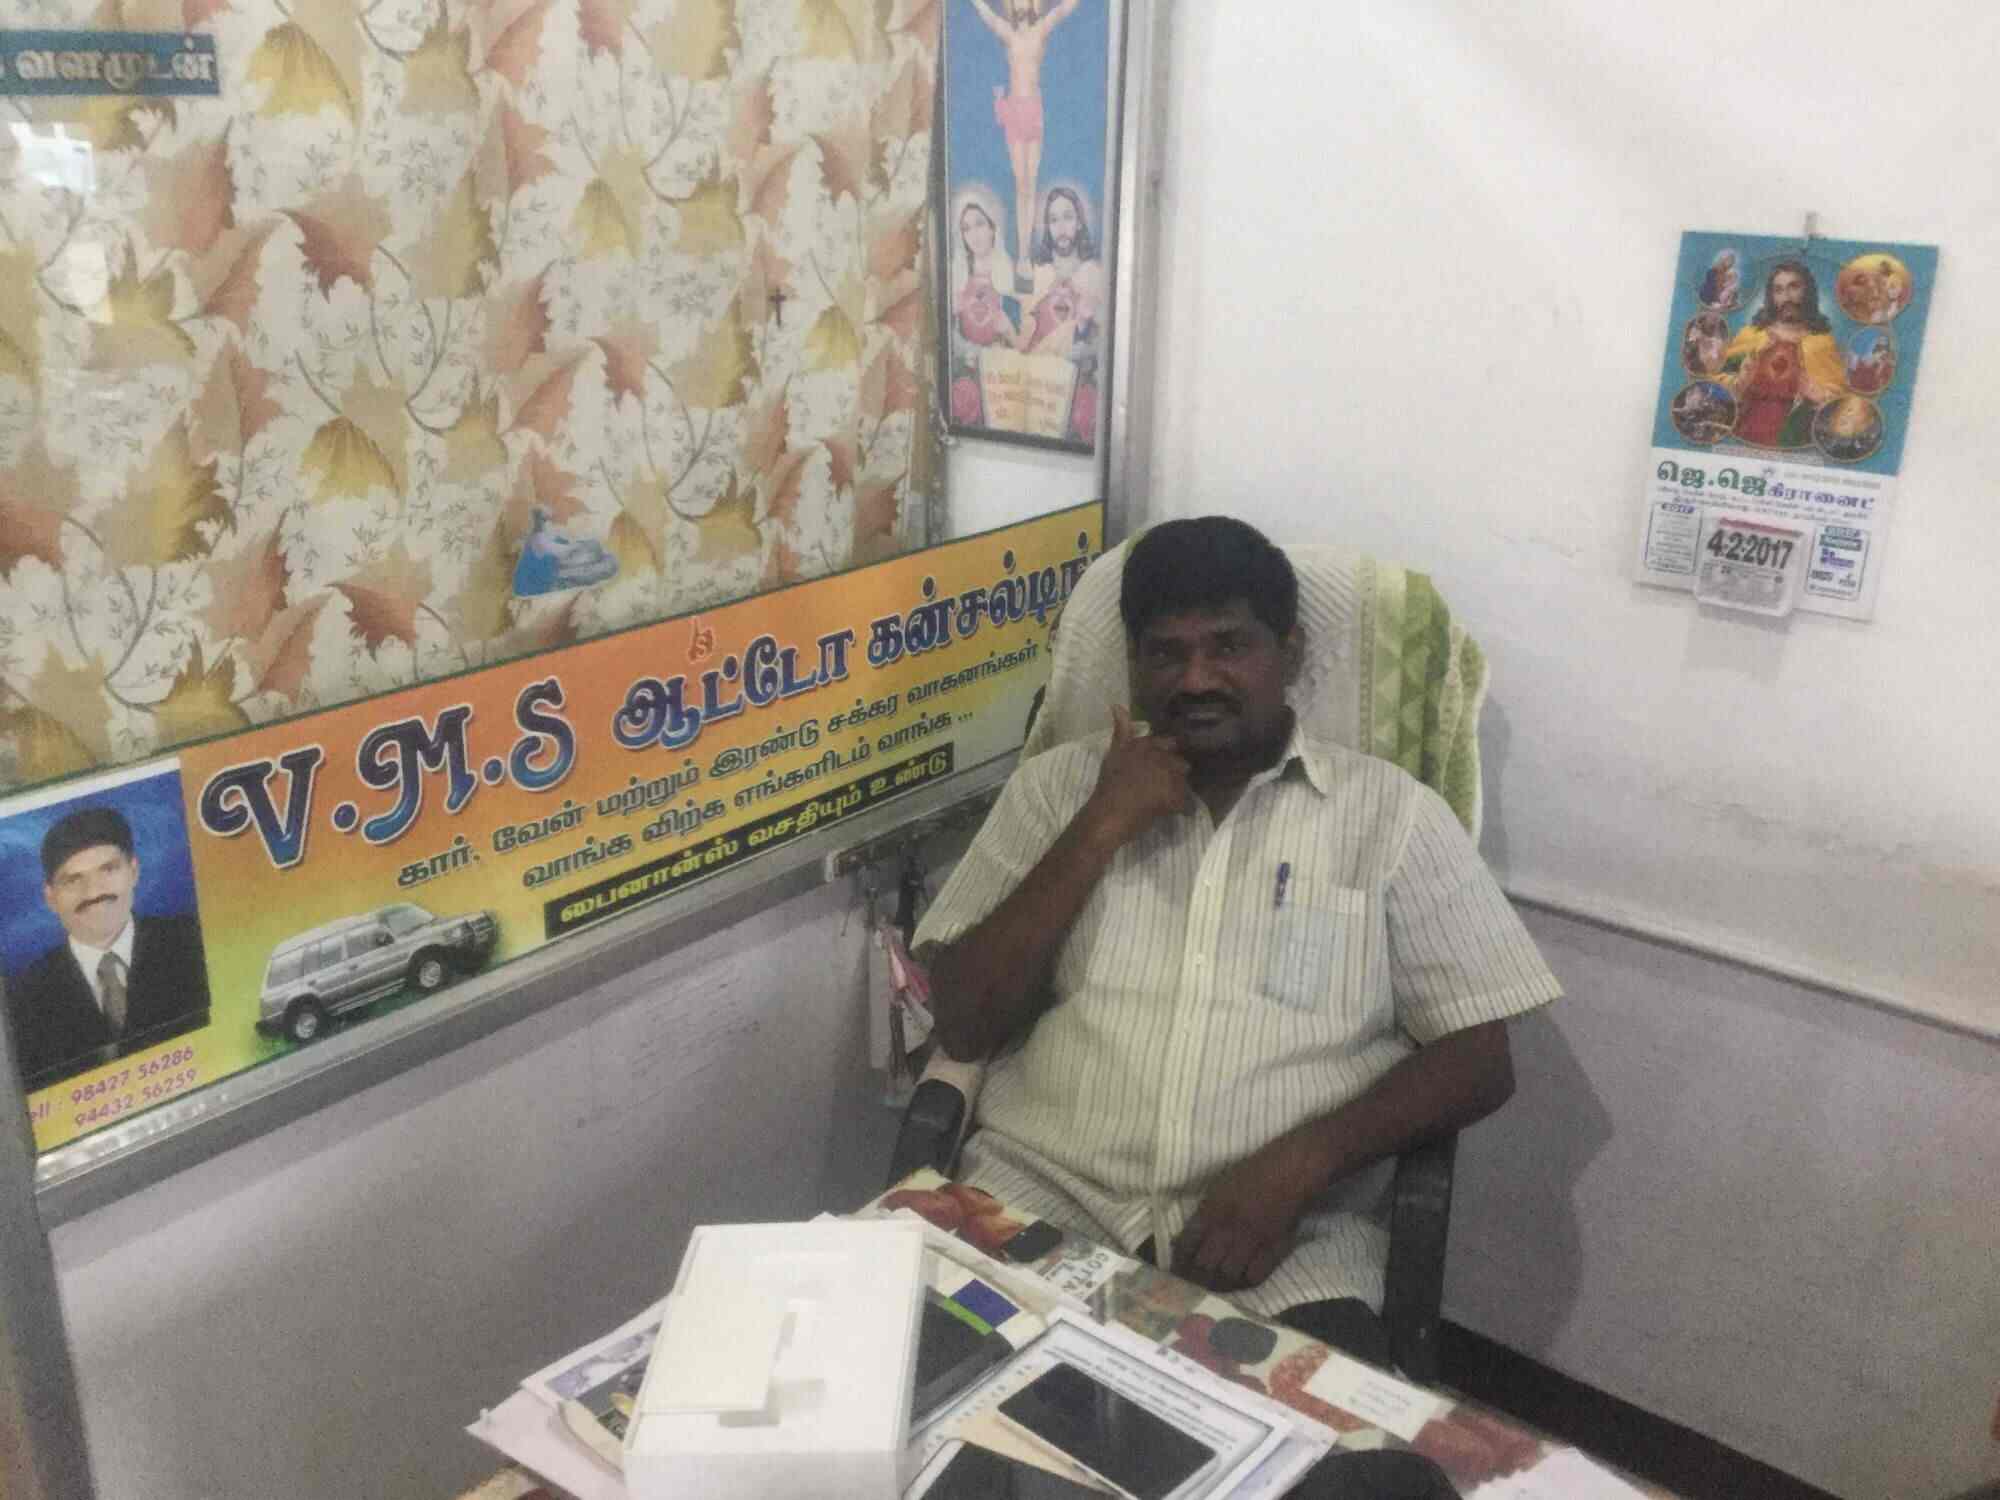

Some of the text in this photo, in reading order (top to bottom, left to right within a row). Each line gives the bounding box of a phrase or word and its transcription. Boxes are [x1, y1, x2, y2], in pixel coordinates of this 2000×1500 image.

[199, 676, 576, 870] V.M.S
[612, 634, 854, 749] ஆட்டோ
[492, 800, 587, 853] வேன்
[596, 759, 701, 818] மற்றும்
[709, 718, 820, 779] இரண்டு
[828, 695, 900, 734] சக்கர
[907, 638, 1039, 703] வாகனங்கள்
[522, 835, 633, 888] வாங்க
[642, 791, 726, 842] விற்க
[734, 736, 873, 809] எங்களிடம்
[877, 712, 953, 754] வாங்க
[560, 752, 949, 924] பைனான்ஸ் வசதியும் உண்டு
[71, 1070, 130, 1105] 98427
[137, 1046, 194, 1081] 56286
[75, 1094, 133, 1126] 94432
